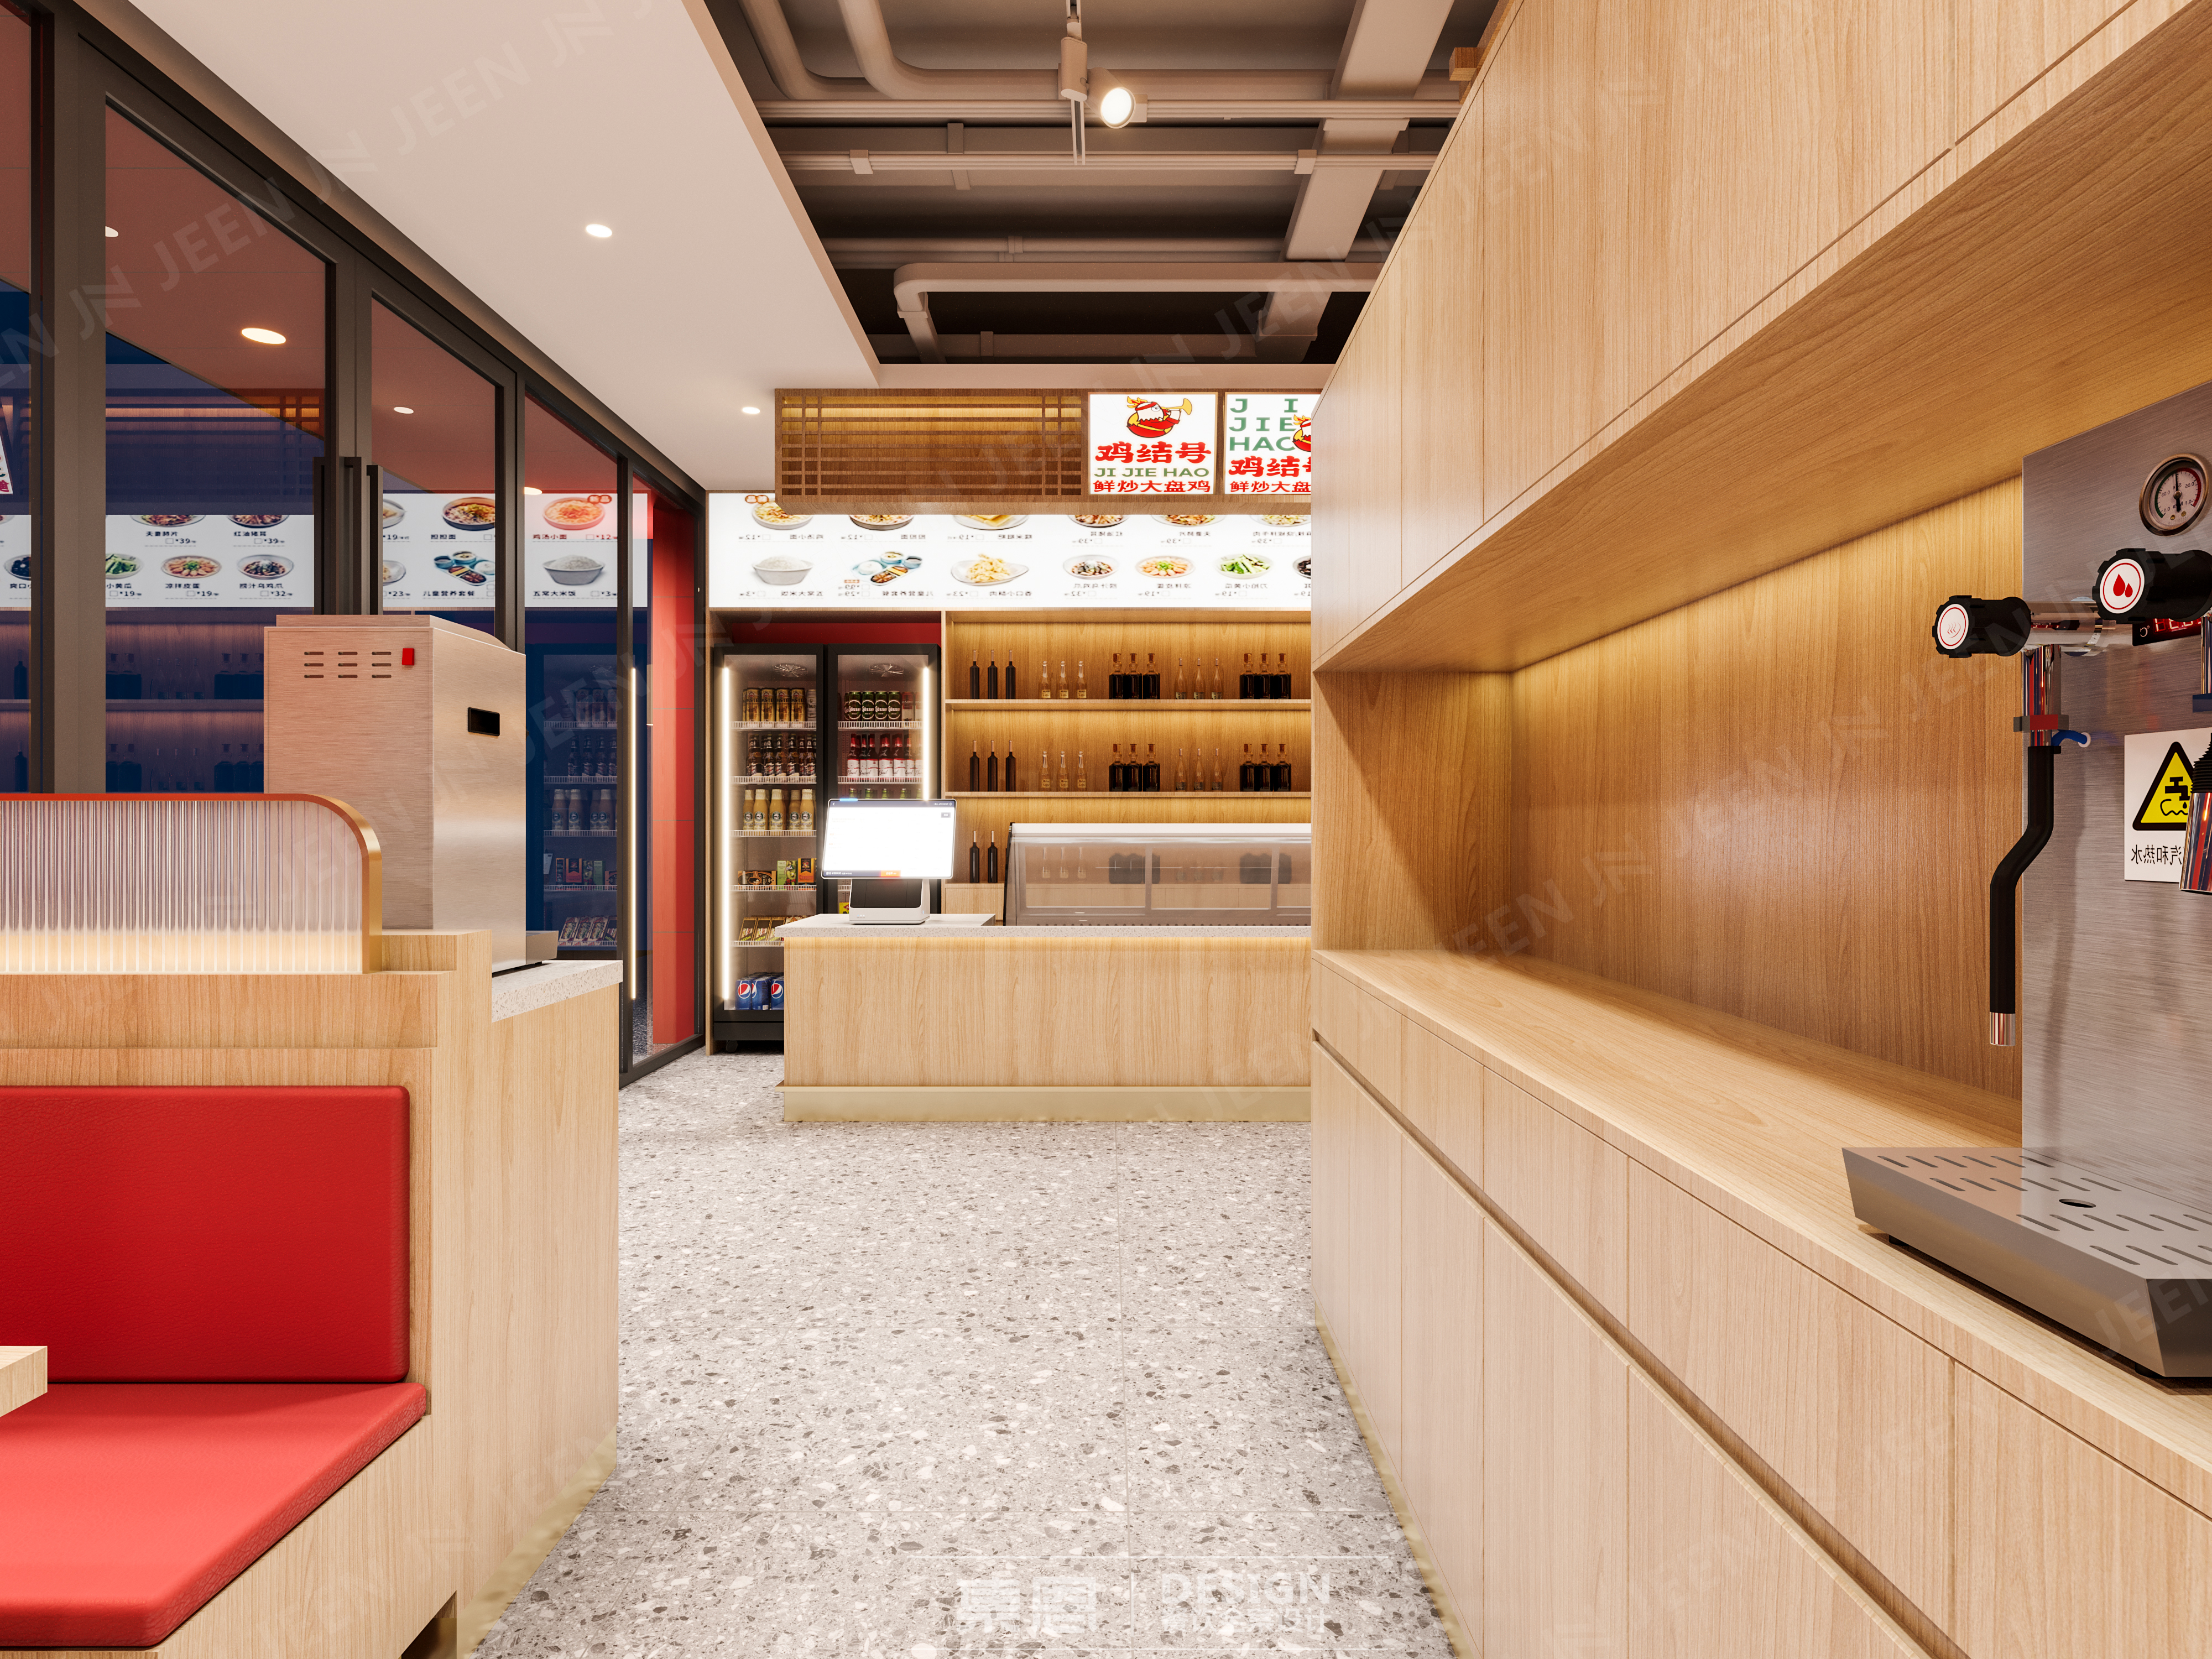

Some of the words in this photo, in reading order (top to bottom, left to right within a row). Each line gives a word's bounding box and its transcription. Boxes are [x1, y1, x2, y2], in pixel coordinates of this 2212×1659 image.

[1229, 417, 1297, 432] JIE
[1094, 441, 1212, 465] 鸡结号
[1094, 468, 1117, 477] JI
[1121, 468, 1157, 477] JIE
[1164, 467, 1209, 477] HAO
[1228, 455, 1311, 478] 鸡结
[1093, 479, 1211, 493] 鲜炒大盘鸡
